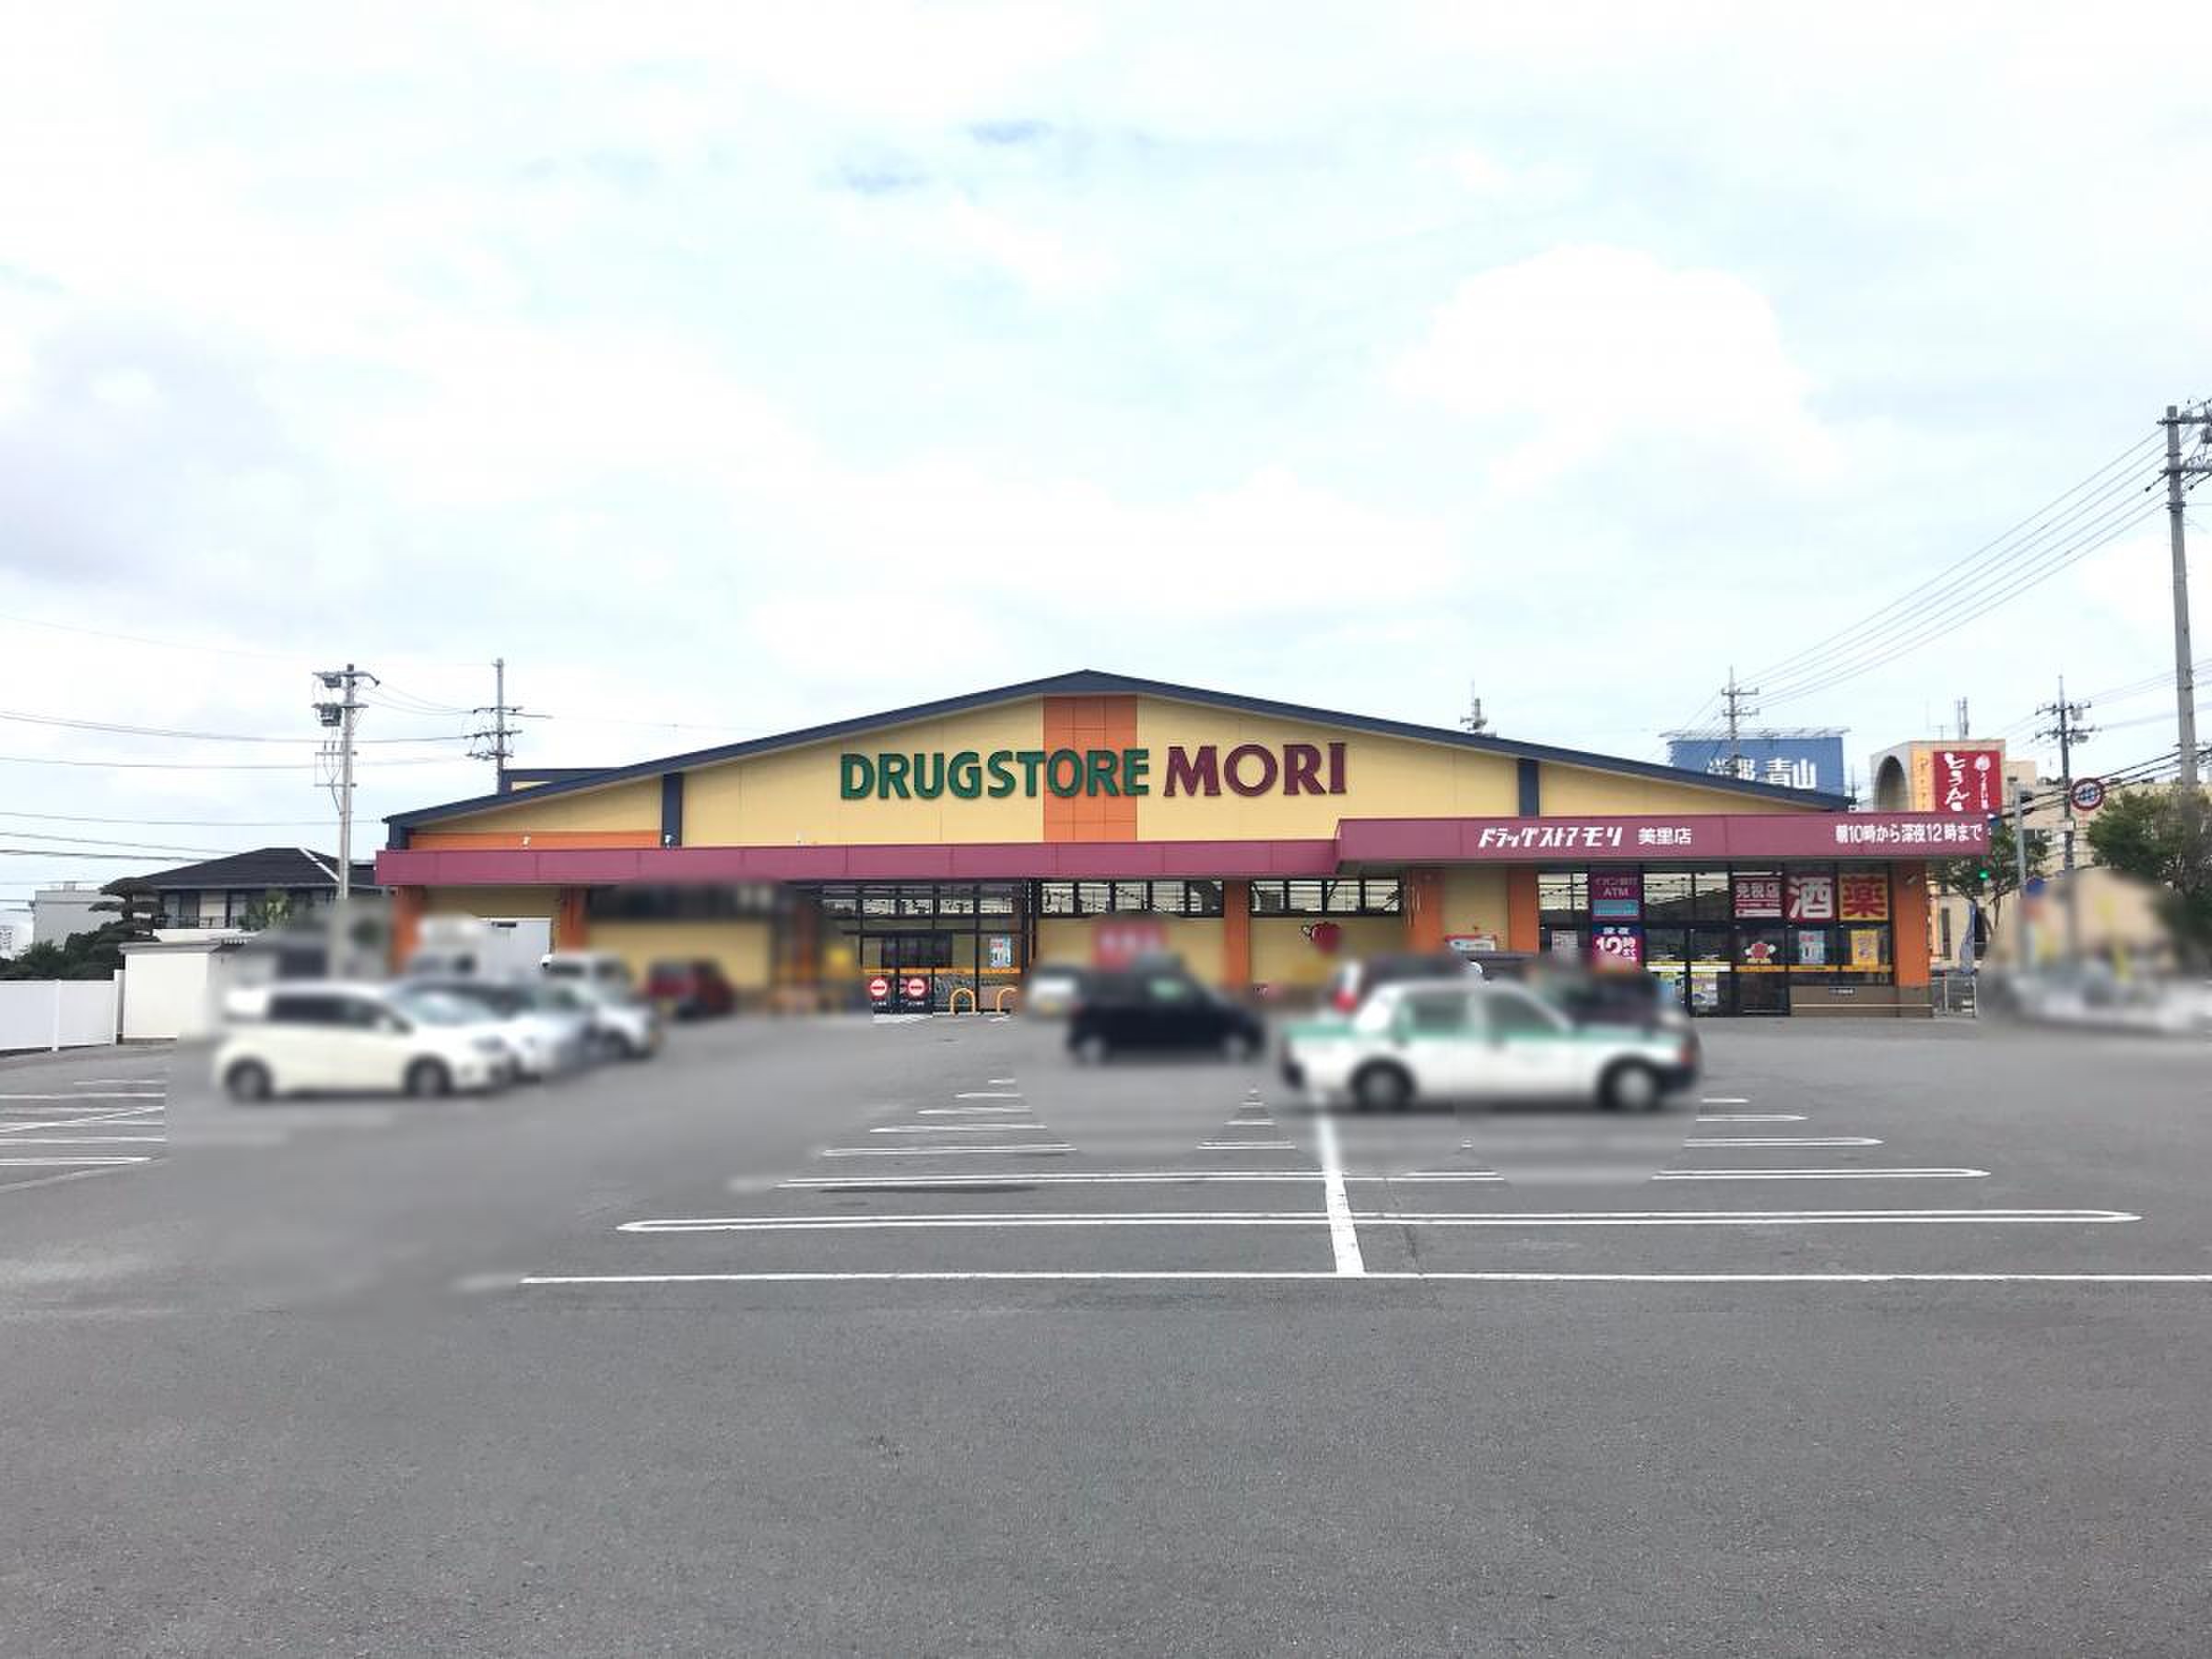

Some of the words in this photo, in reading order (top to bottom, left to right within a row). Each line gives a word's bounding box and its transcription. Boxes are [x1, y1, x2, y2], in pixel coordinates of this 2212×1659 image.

[840, 748, 1150, 800] DRUGSTORE
[1163, 742, 1348, 797] MORI
[1638, 828, 1691, 845] 美里店
[1835, 823, 1983, 843] 朝10時から深夜12時まで
[1603, 888, 1630, 897] ATM
[1735, 882, 1780, 899] 免税店
[1789, 877, 1832, 918] 酒
[1841, 877, 1886, 918] 薬
